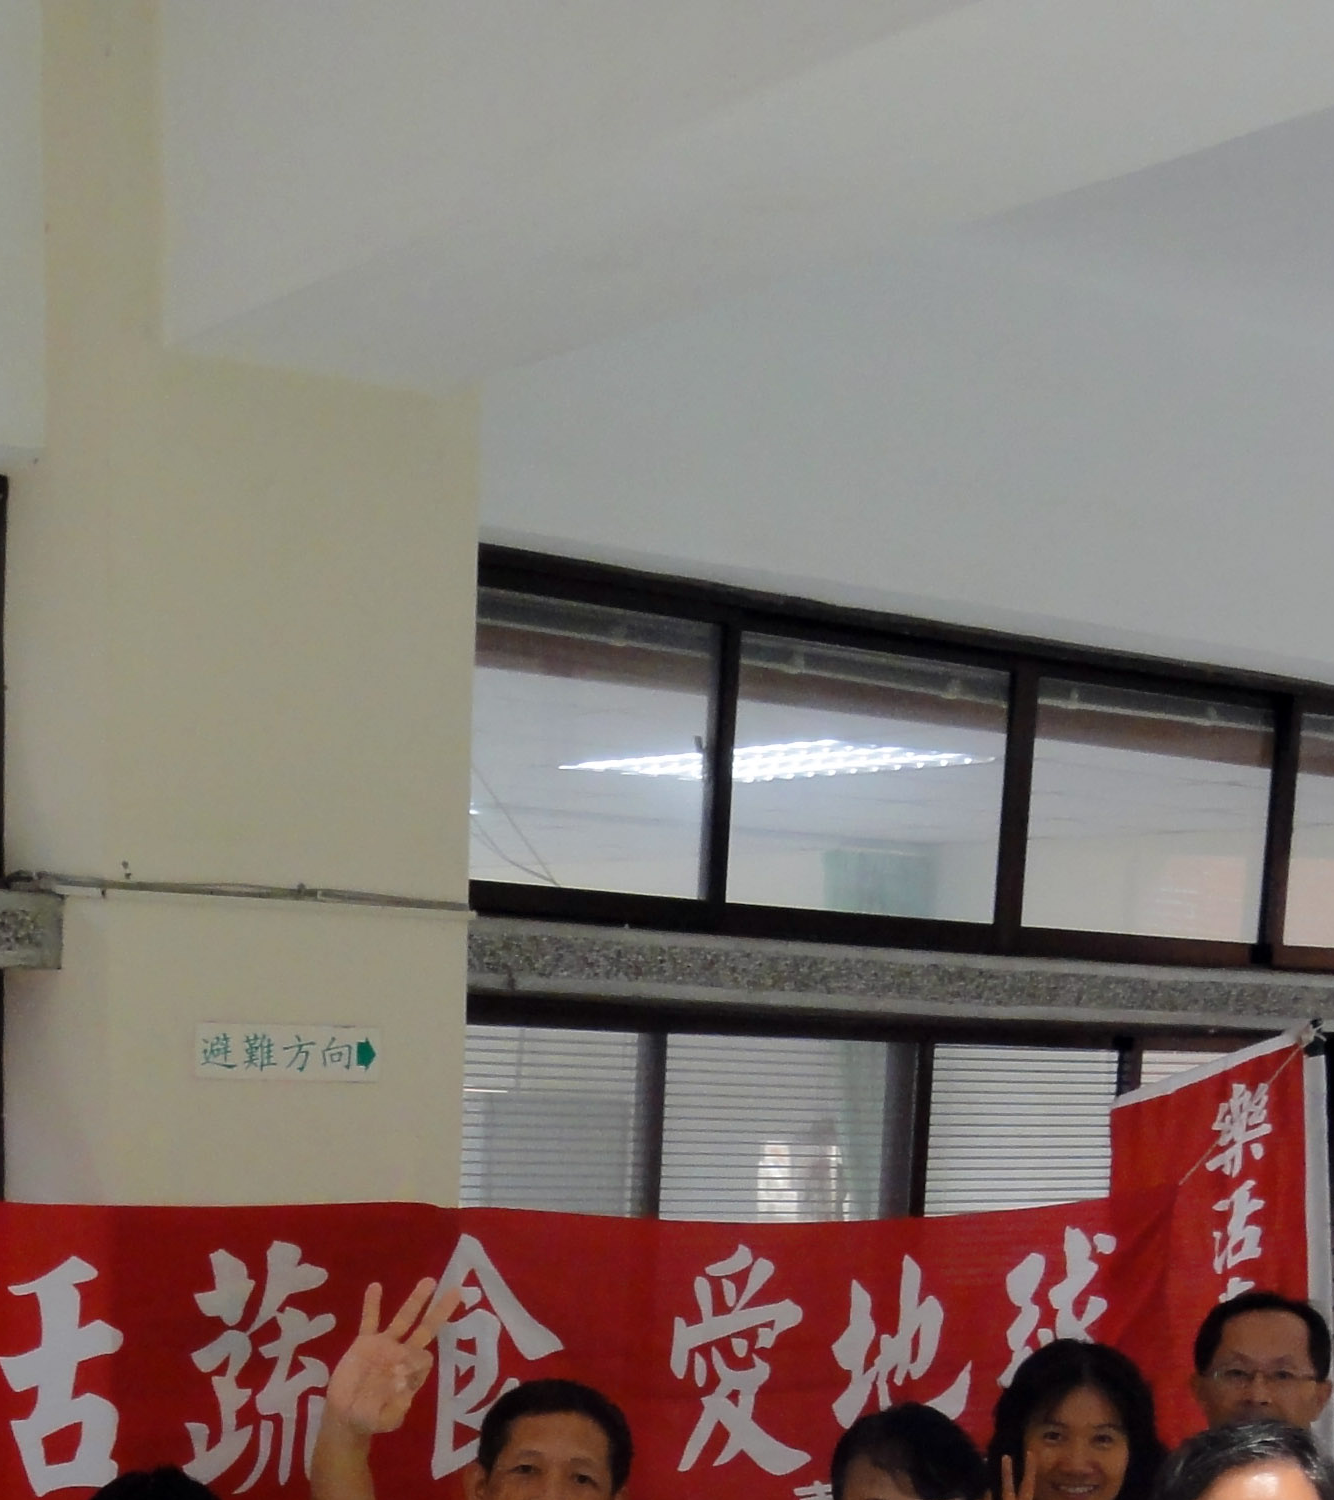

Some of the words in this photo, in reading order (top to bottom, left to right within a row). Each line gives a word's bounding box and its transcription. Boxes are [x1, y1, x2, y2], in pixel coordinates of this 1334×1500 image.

[200, 1032, 353, 1073] 避難方向
[1205, 1083, 1273, 1304] 樂活
